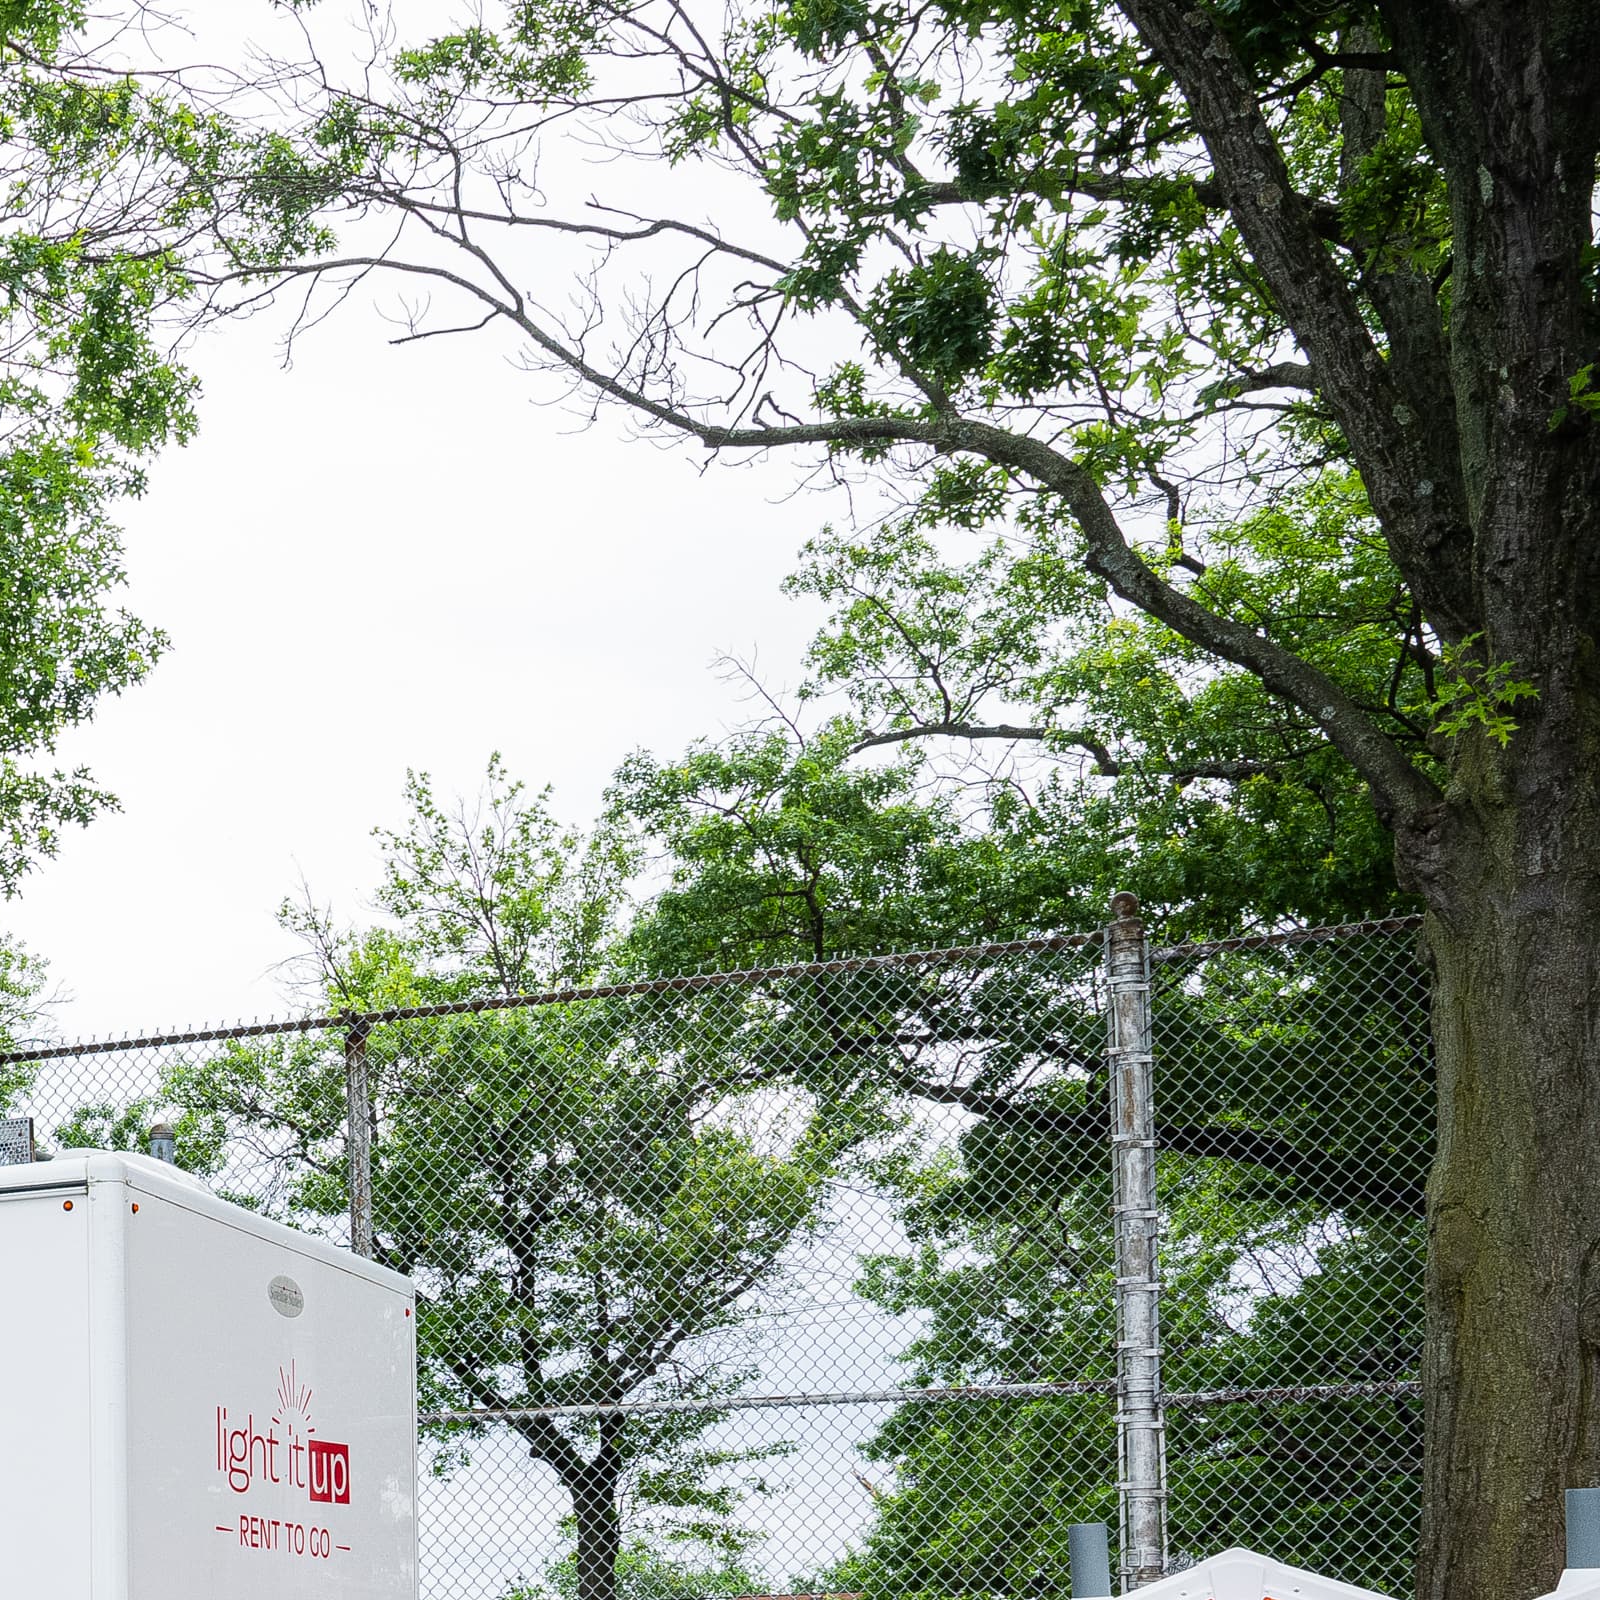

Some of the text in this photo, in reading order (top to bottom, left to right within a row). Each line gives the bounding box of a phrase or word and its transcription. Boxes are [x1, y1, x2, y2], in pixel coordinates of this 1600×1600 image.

[216, 1406, 347, 1503] light it up
[240, 1514, 330, 1559] RENT TO GO
